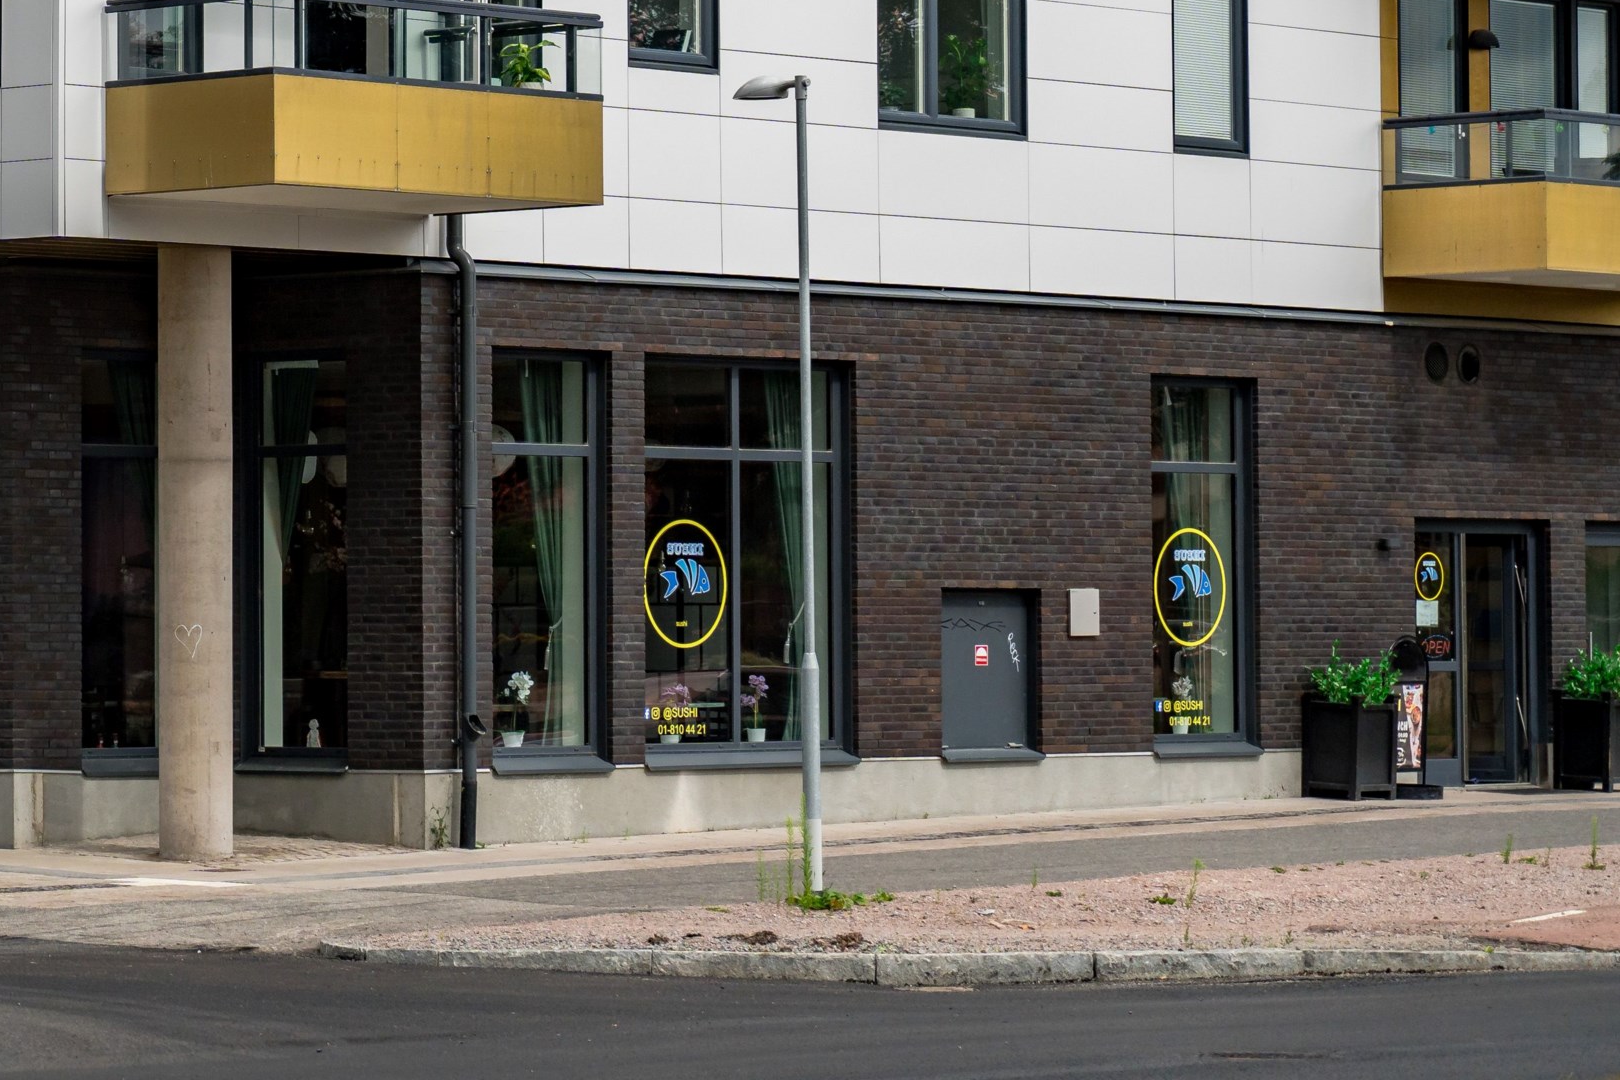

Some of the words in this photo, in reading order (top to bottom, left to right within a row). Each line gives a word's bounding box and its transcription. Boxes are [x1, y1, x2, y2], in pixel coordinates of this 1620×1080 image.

[666, 542, 704, 556] SUSHI
[1173, 700, 1204, 713] @SUSHI
[663, 707, 698, 720] @SUSHI
[1202, 716, 1211, 726] 21
[657, 724, 685, 735] 01-810
[685, 724, 696, 735] 44
[697, 723, 707, 735] 21
